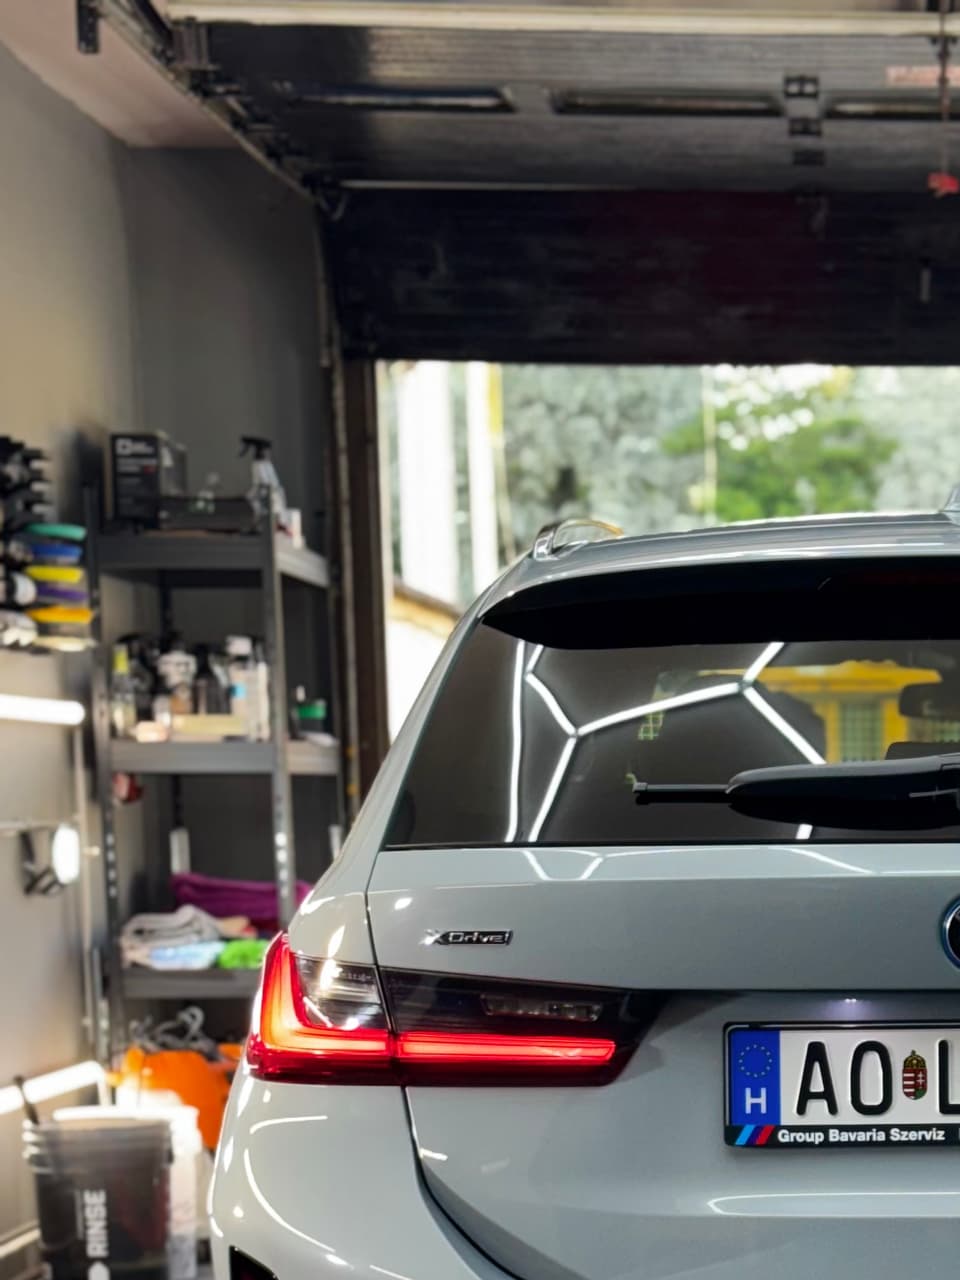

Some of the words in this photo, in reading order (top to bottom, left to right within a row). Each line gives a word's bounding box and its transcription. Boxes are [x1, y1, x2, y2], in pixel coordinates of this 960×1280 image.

[745, 1087, 767, 1114] H
[777, 1130, 824, 1144] Group
[829, 1128, 886, 1142] Bavaria
[890, 1127, 946, 1141] Szerviz
[84, 1190, 108, 1258] RINSE
